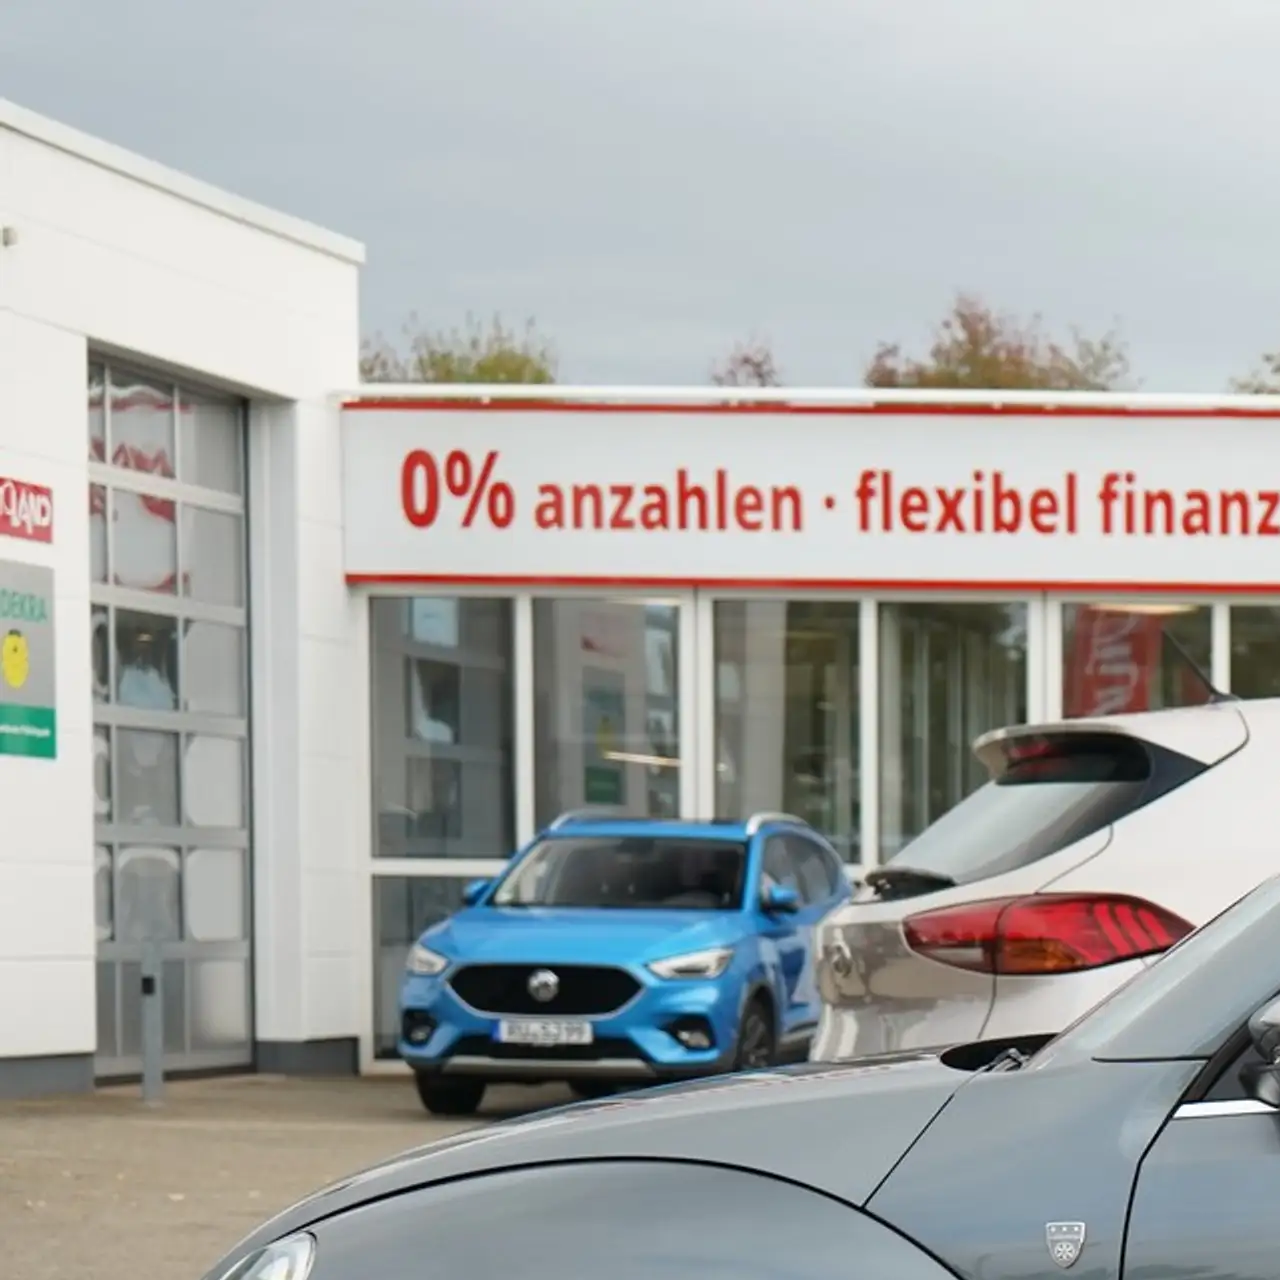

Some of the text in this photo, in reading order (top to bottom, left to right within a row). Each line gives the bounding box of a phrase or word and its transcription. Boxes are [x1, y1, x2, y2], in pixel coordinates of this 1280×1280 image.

[400, 449, 515, 529] 0%
[535, 469, 803, 531] anzahlen
[856, 470, 1078, 534] flexibel
